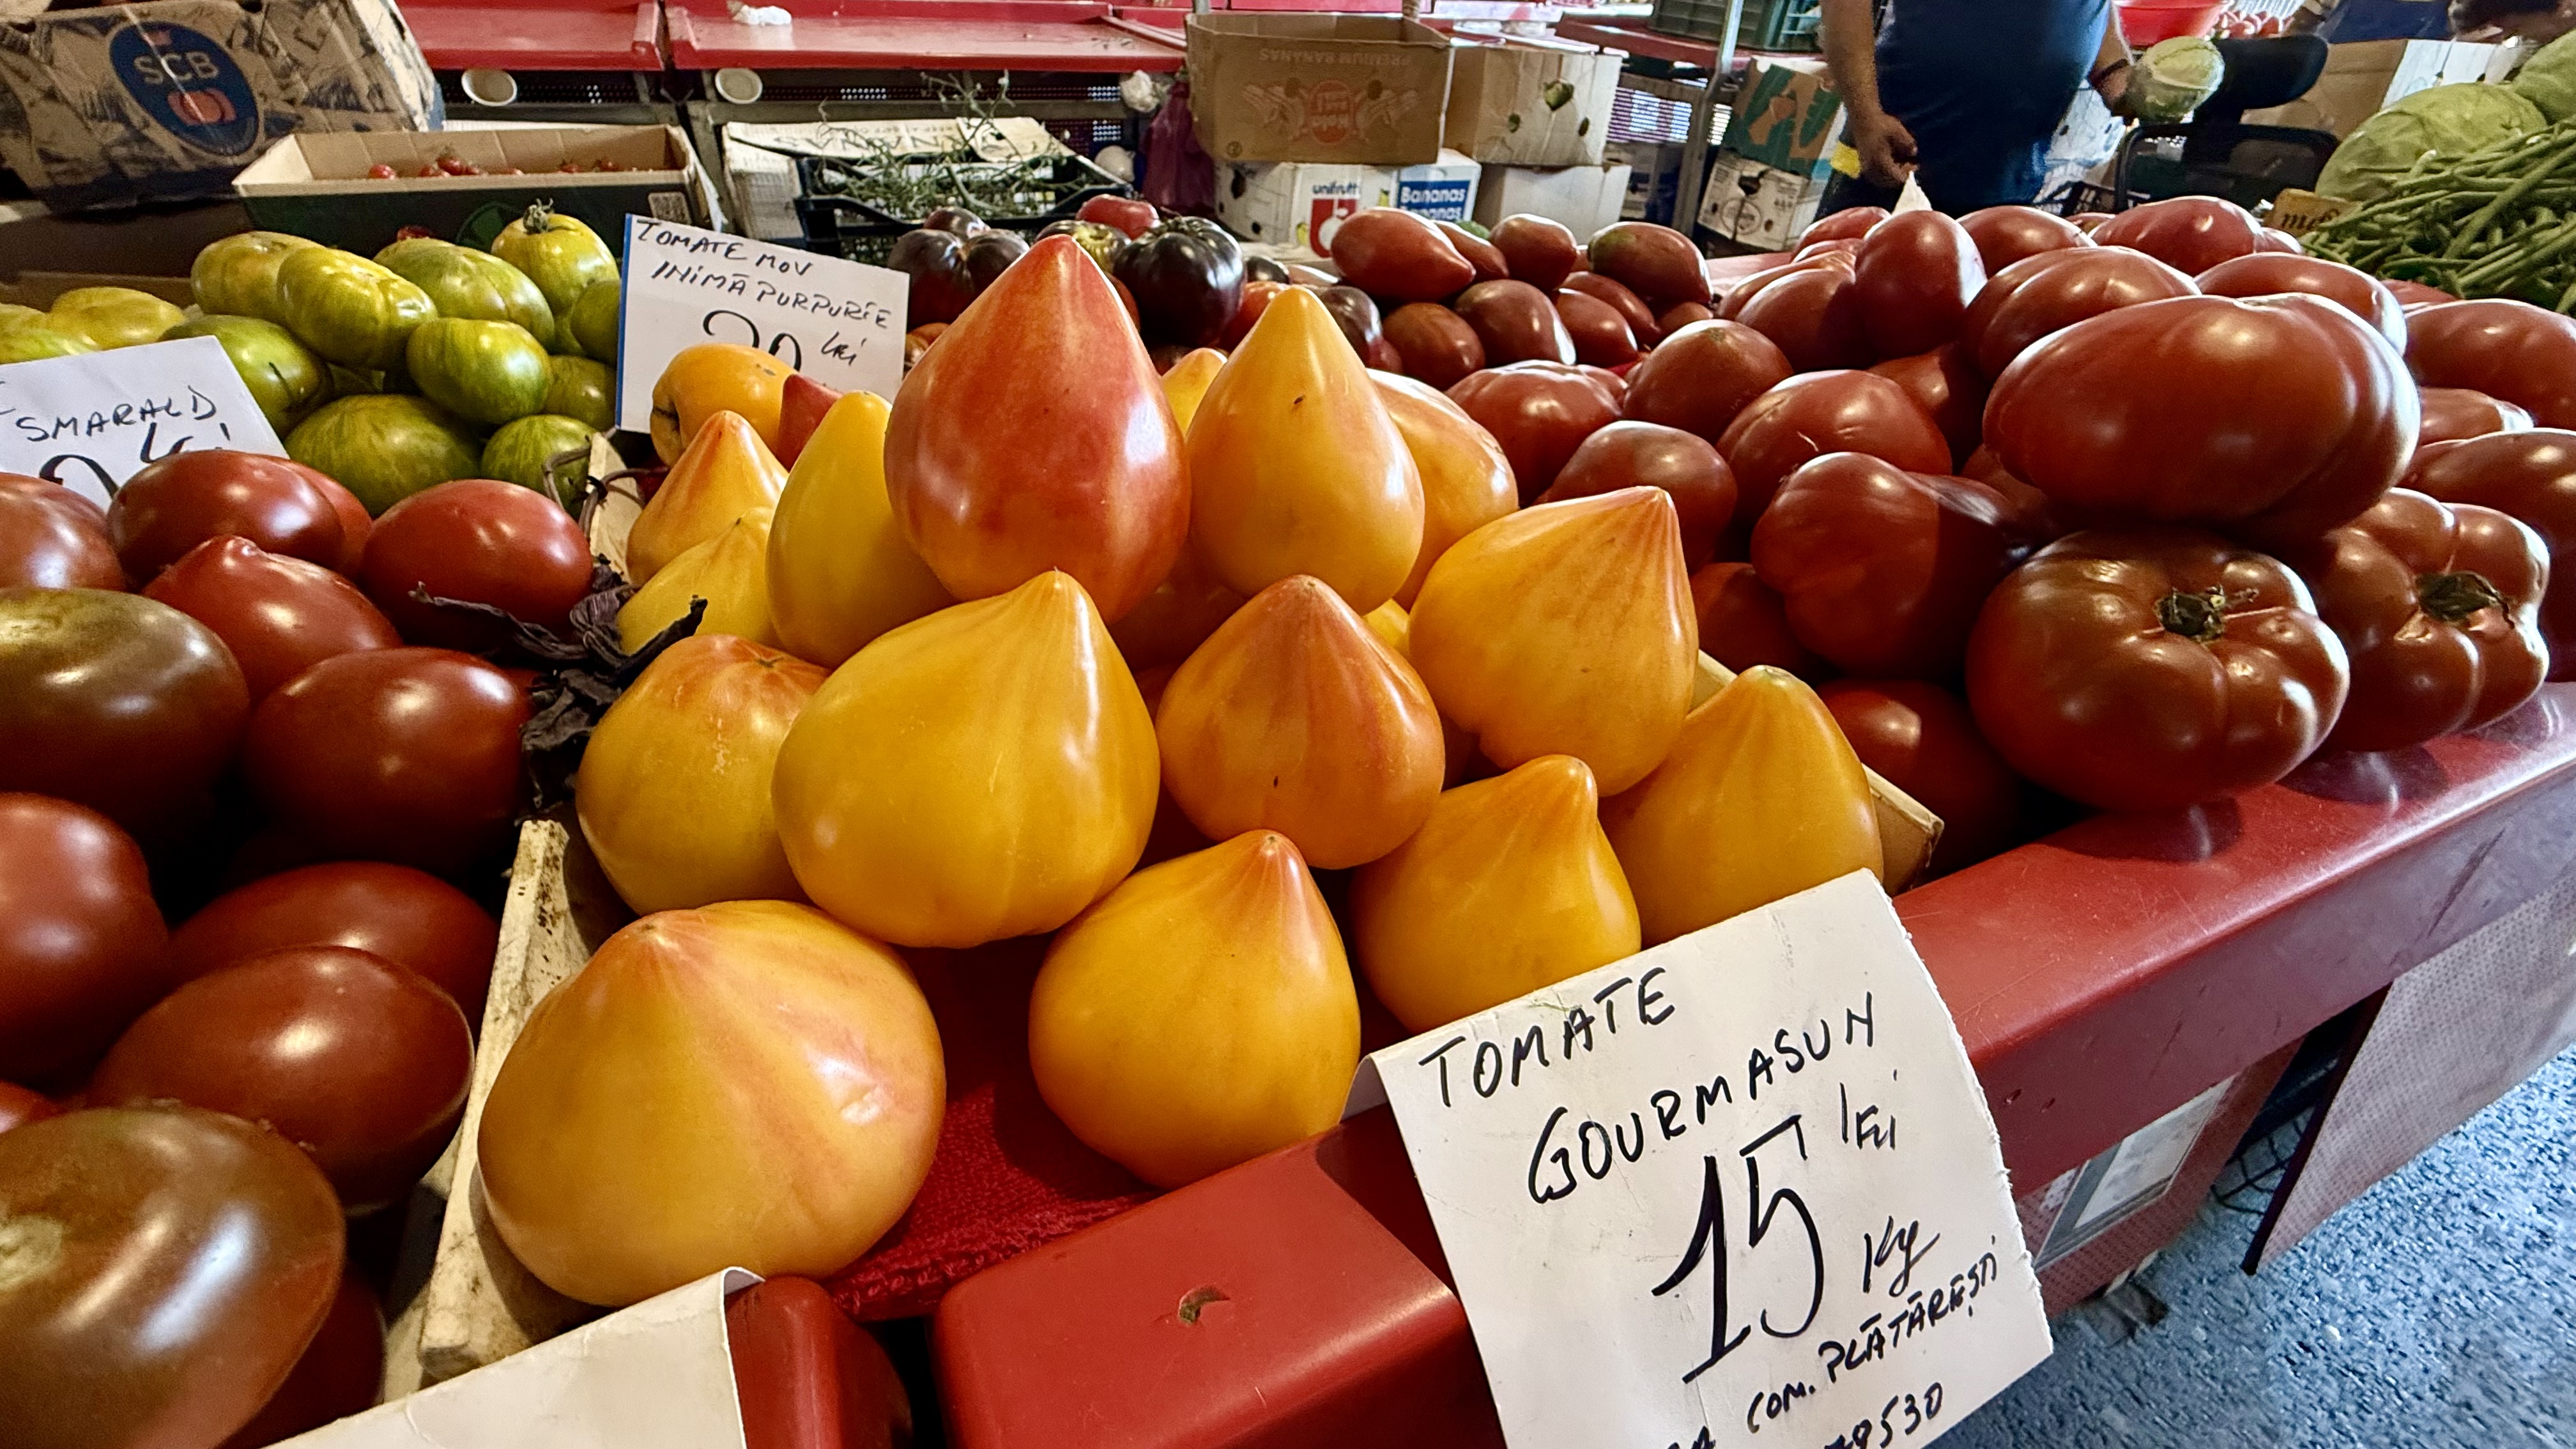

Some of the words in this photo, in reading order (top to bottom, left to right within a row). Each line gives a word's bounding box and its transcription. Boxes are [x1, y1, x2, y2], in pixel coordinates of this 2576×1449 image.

[133, 50, 219, 84] SCB
[1400, 187, 1466, 204] Bananas
[636, 219, 747, 260] TOMATE
[755, 254, 813, 276] MOV
[15, 385, 217, 442] SMARALD
[1418, 967, 1675, 1108] TOMATE
[1528, 991, 1874, 1204] GOURMASUN
[1651, 1114, 1825, 1384] 15
[1747, 1381, 1816, 1434] COM.
